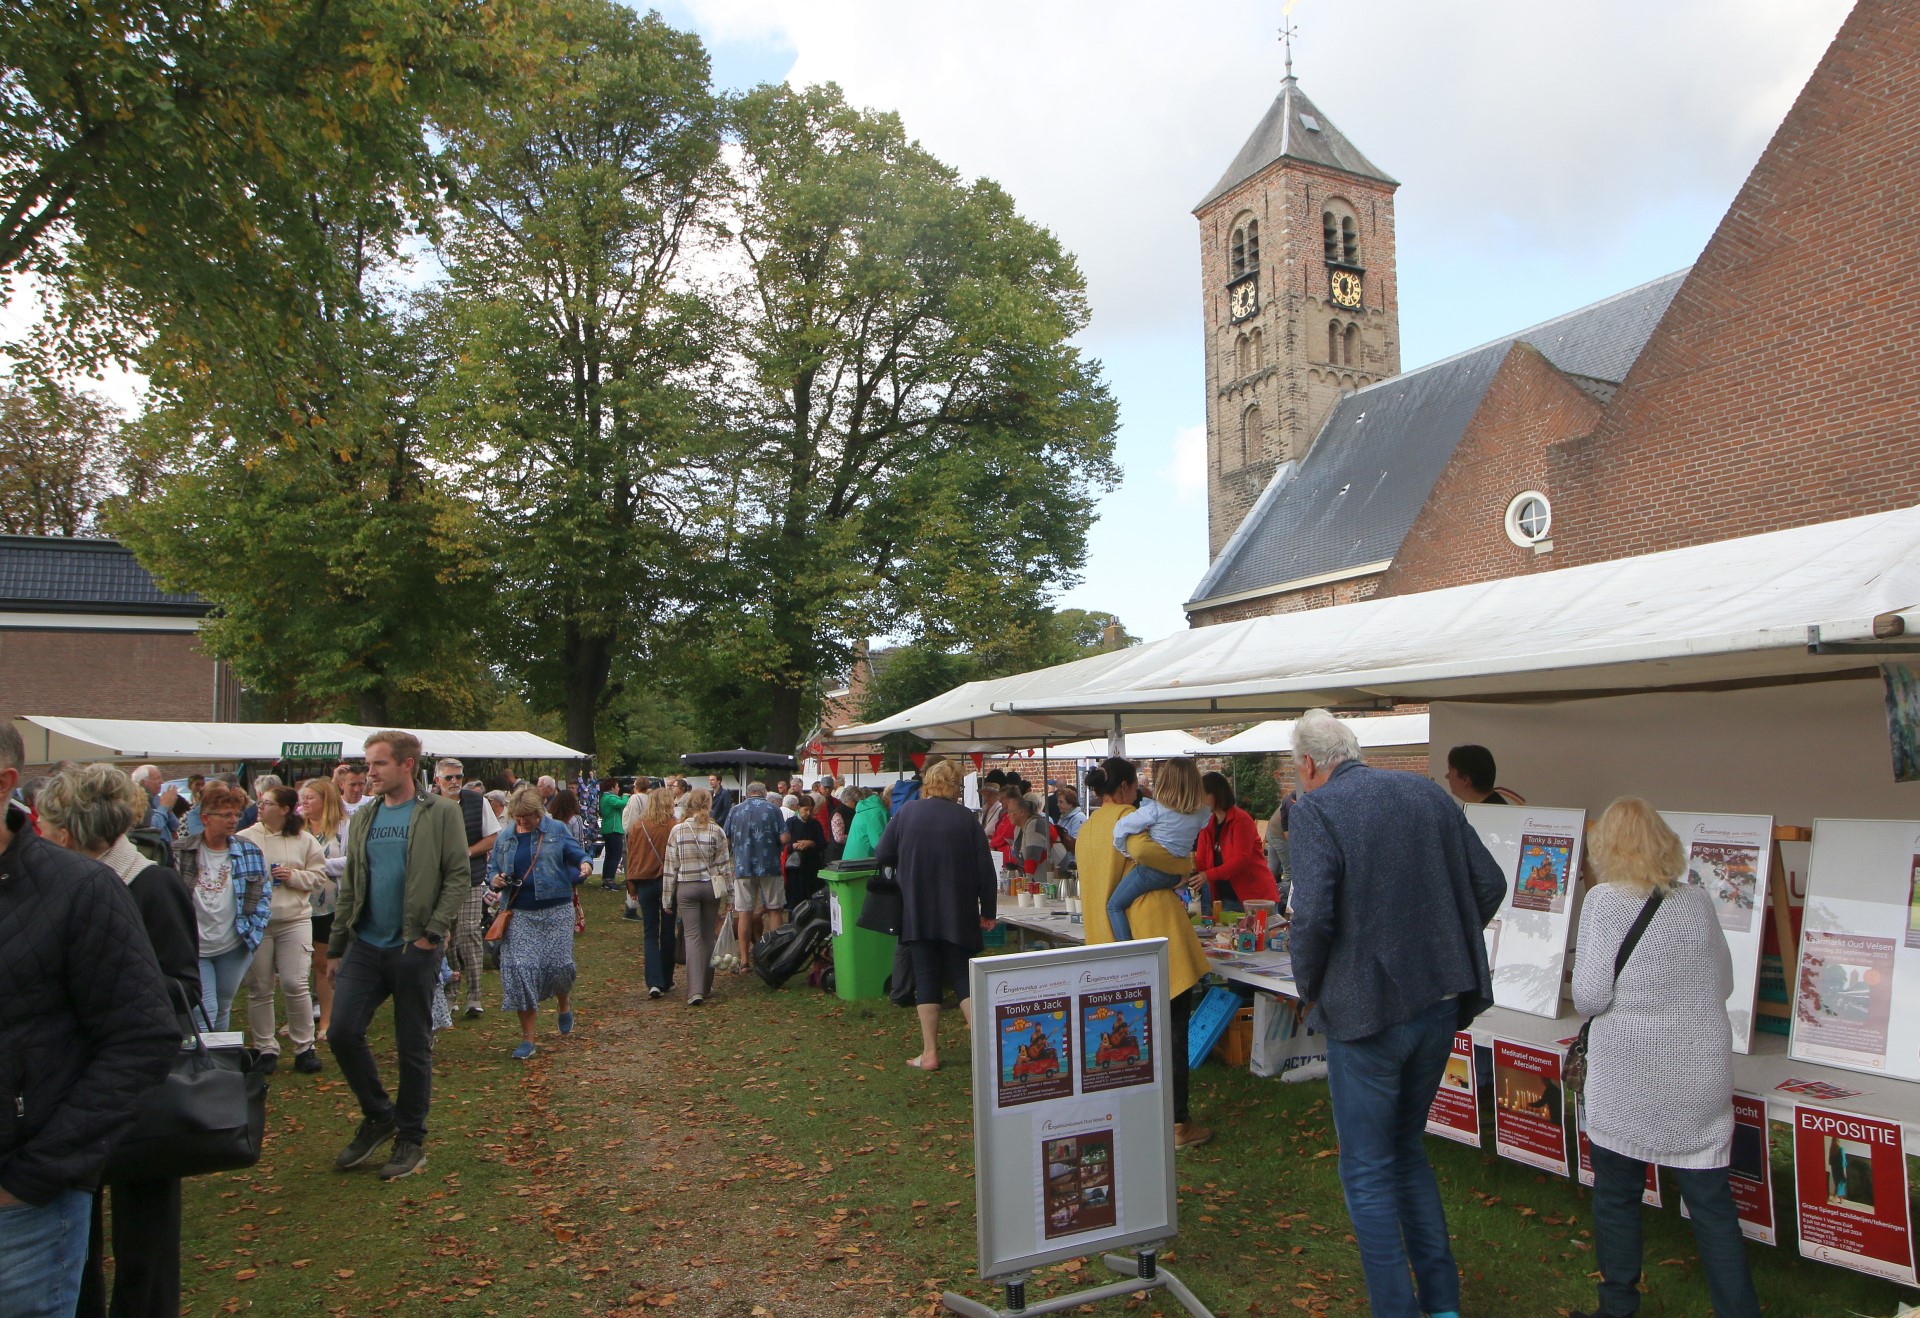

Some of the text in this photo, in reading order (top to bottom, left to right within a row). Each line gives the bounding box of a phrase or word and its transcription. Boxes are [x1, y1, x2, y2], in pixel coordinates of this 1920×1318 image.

[285, 743, 340, 756] KERKKRAAM
[1528, 836, 1546, 845] Tonky
[1847, 940, 1864, 949] Oud
[1866, 942, 1893, 951] Velsen
[1088, 994, 1113, 1004] Tonky
[1115, 991, 1122, 1000] &
[1124, 989, 1143, 999] Jack
[1005, 1000, 1063, 1015] Tonky & Jack
[1501, 1047, 1552, 1066] Meditatief moment
[1513, 1059, 1542, 1072] Allerzielen
[1734, 1104, 1759, 1119] ocht
[1801, 1113, 1896, 1146] EXPOSITIE
[1801, 1202, 1819, 1212] Grace
[1819, 1206, 1839, 1216] Spiegel
